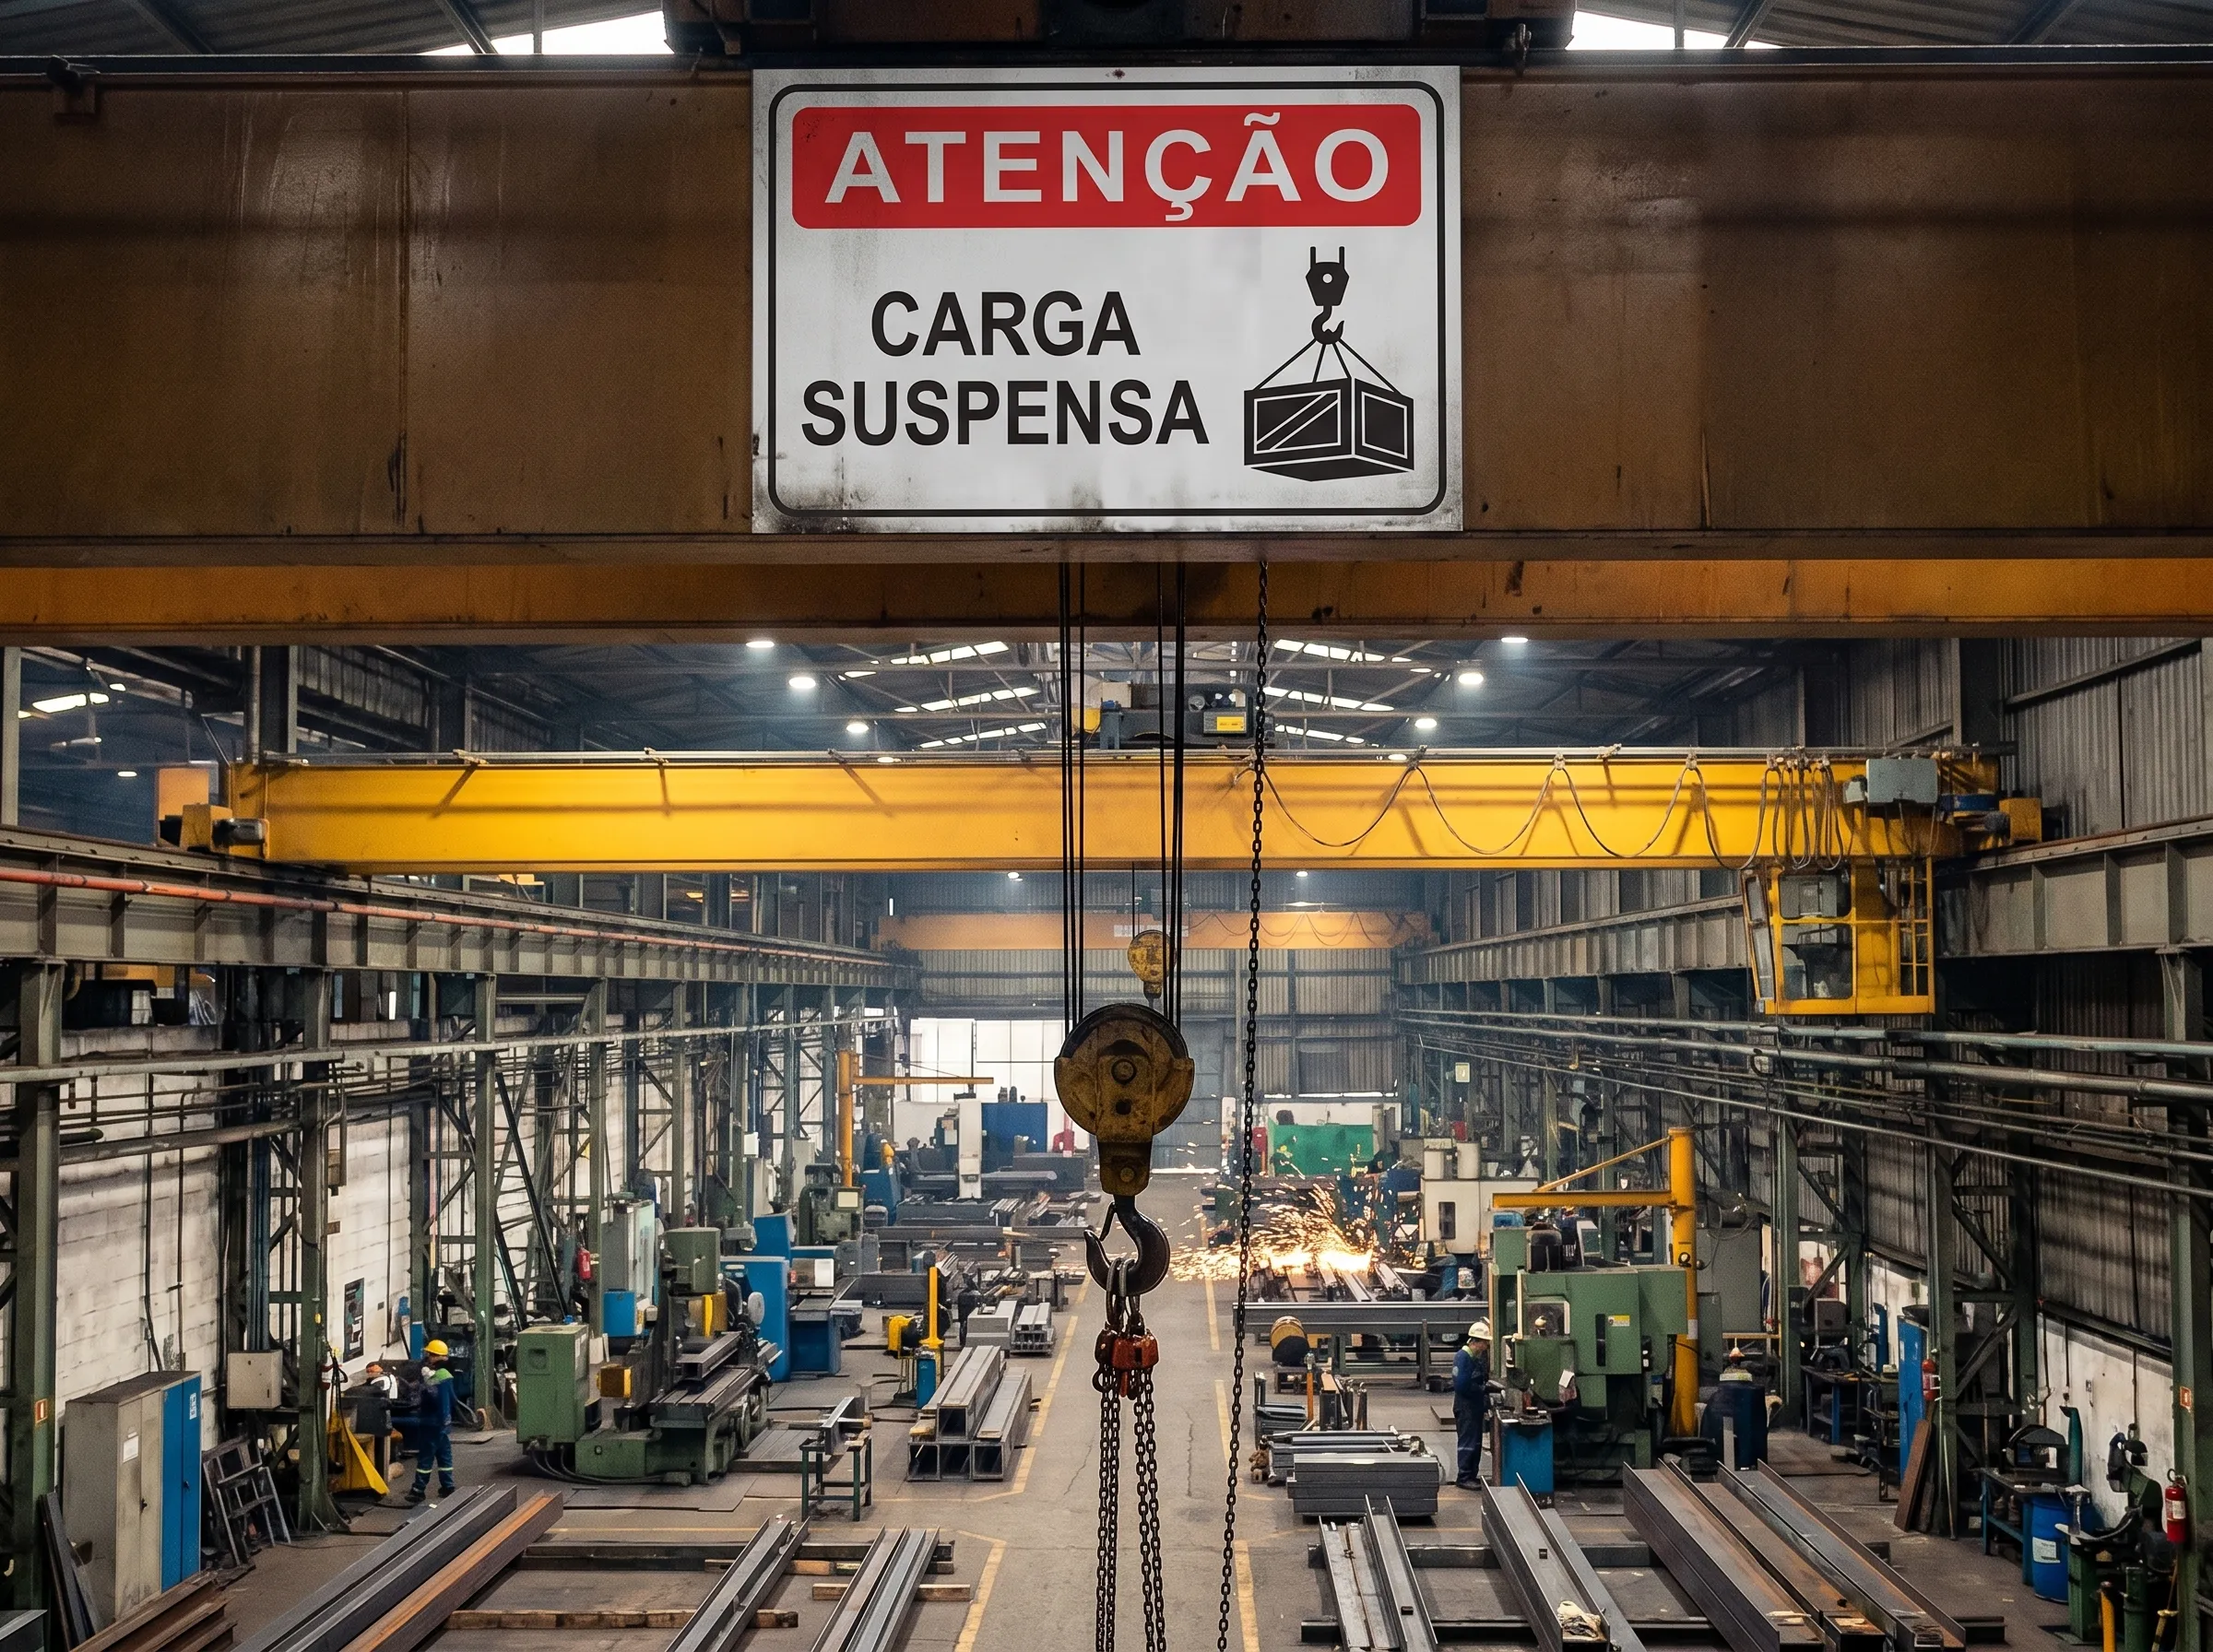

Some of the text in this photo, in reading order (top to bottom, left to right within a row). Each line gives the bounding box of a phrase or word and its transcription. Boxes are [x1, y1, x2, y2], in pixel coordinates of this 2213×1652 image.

[824, 112, 1389, 221] ATENÇÃO
[871, 291, 1141, 357] CARGA
[801, 380, 1210, 446] SUSPENSA
